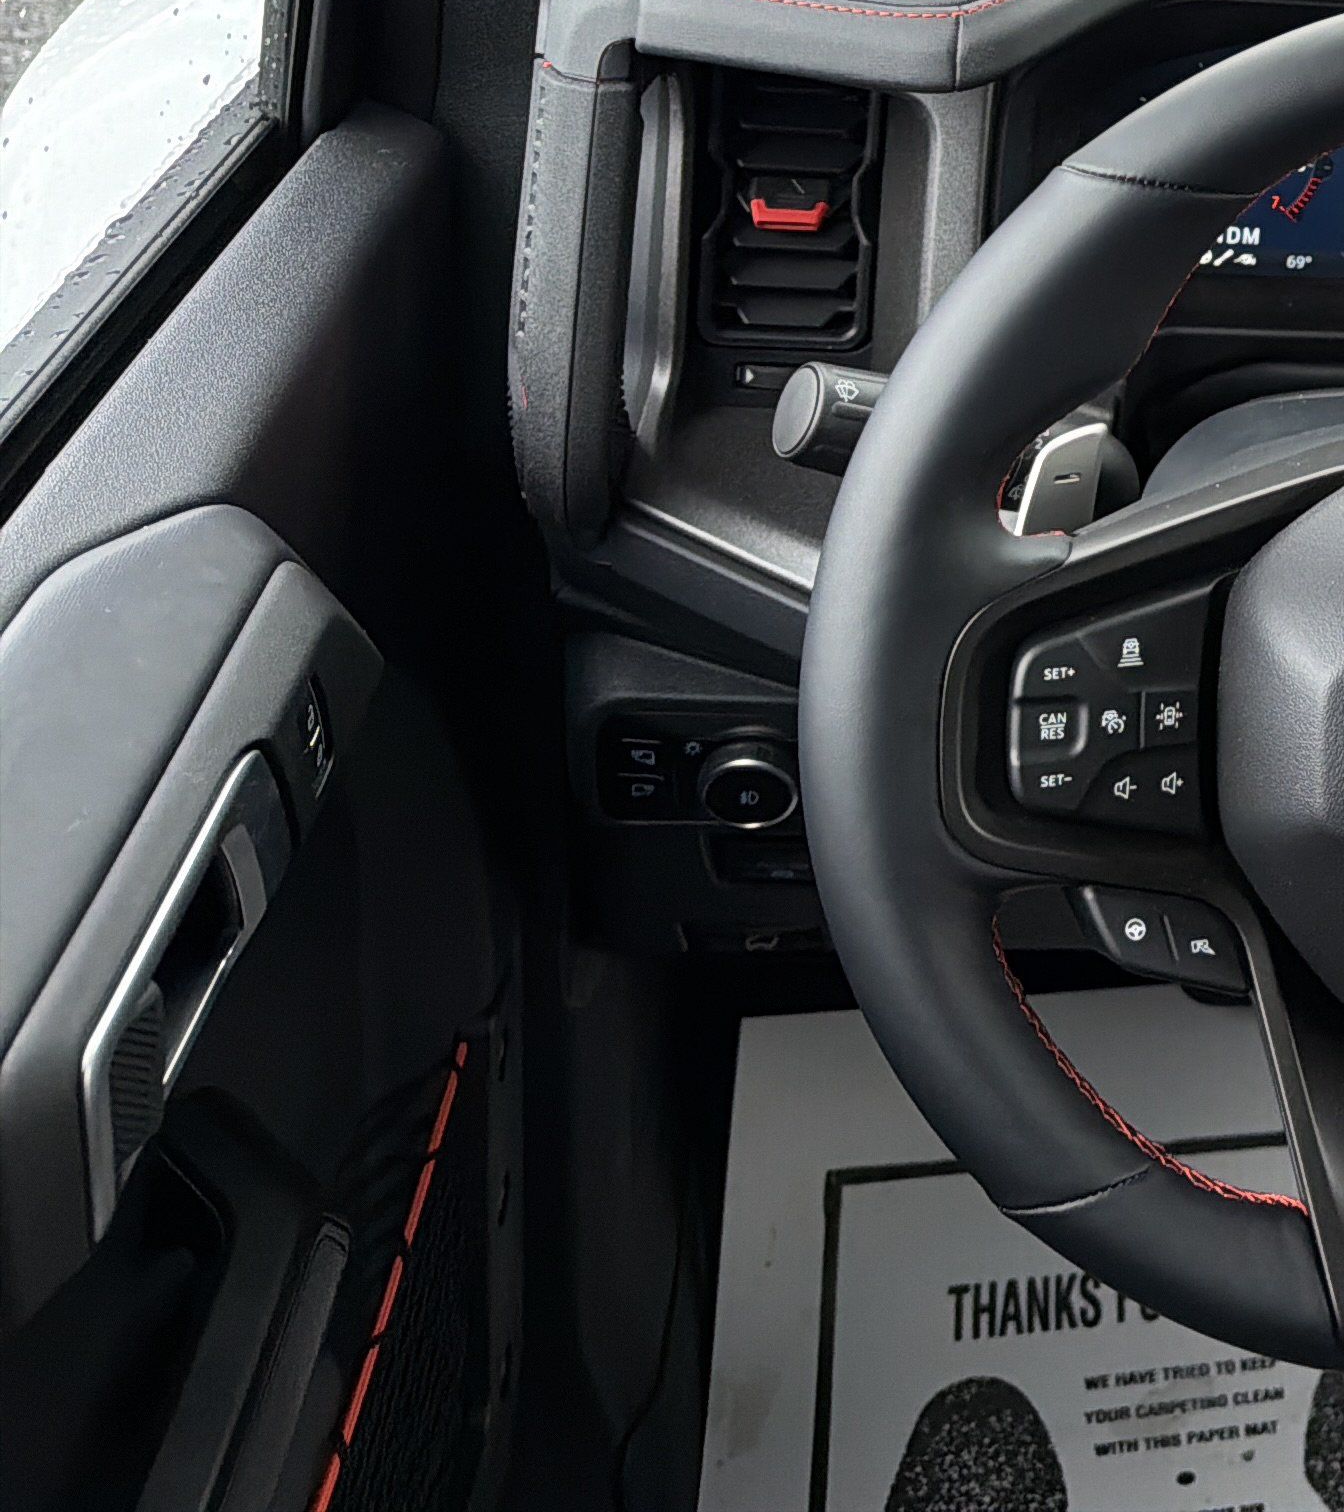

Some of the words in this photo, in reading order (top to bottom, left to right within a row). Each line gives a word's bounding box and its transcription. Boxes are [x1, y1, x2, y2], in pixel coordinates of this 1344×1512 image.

[1043, 665, 1076, 681] SET+
[1039, 712, 1067, 726] CAN
[1040, 726, 1065, 741] RES
[1040, 774, 1073, 788] SET-
[948, 1270, 1101, 1342] THANKS
[1083, 1374, 1111, 1390] WE
[1114, 1367, 1157, 1387] HAVE
[1162, 1364, 1211, 1382] TRIED
[1216, 1359, 1236, 1376] TO
[1084, 1406, 1132, 1425] YOUR
[1135, 1394, 1229, 1419] CARPETING
[1233, 1387, 1285, 1406] CLEAN
[1093, 1437, 1139, 1457] WITH
[1144, 1433, 1182, 1451] THIS
[1187, 1425, 1241, 1445] PAPER
[1244, 1420, 1279, 1437] MAT
